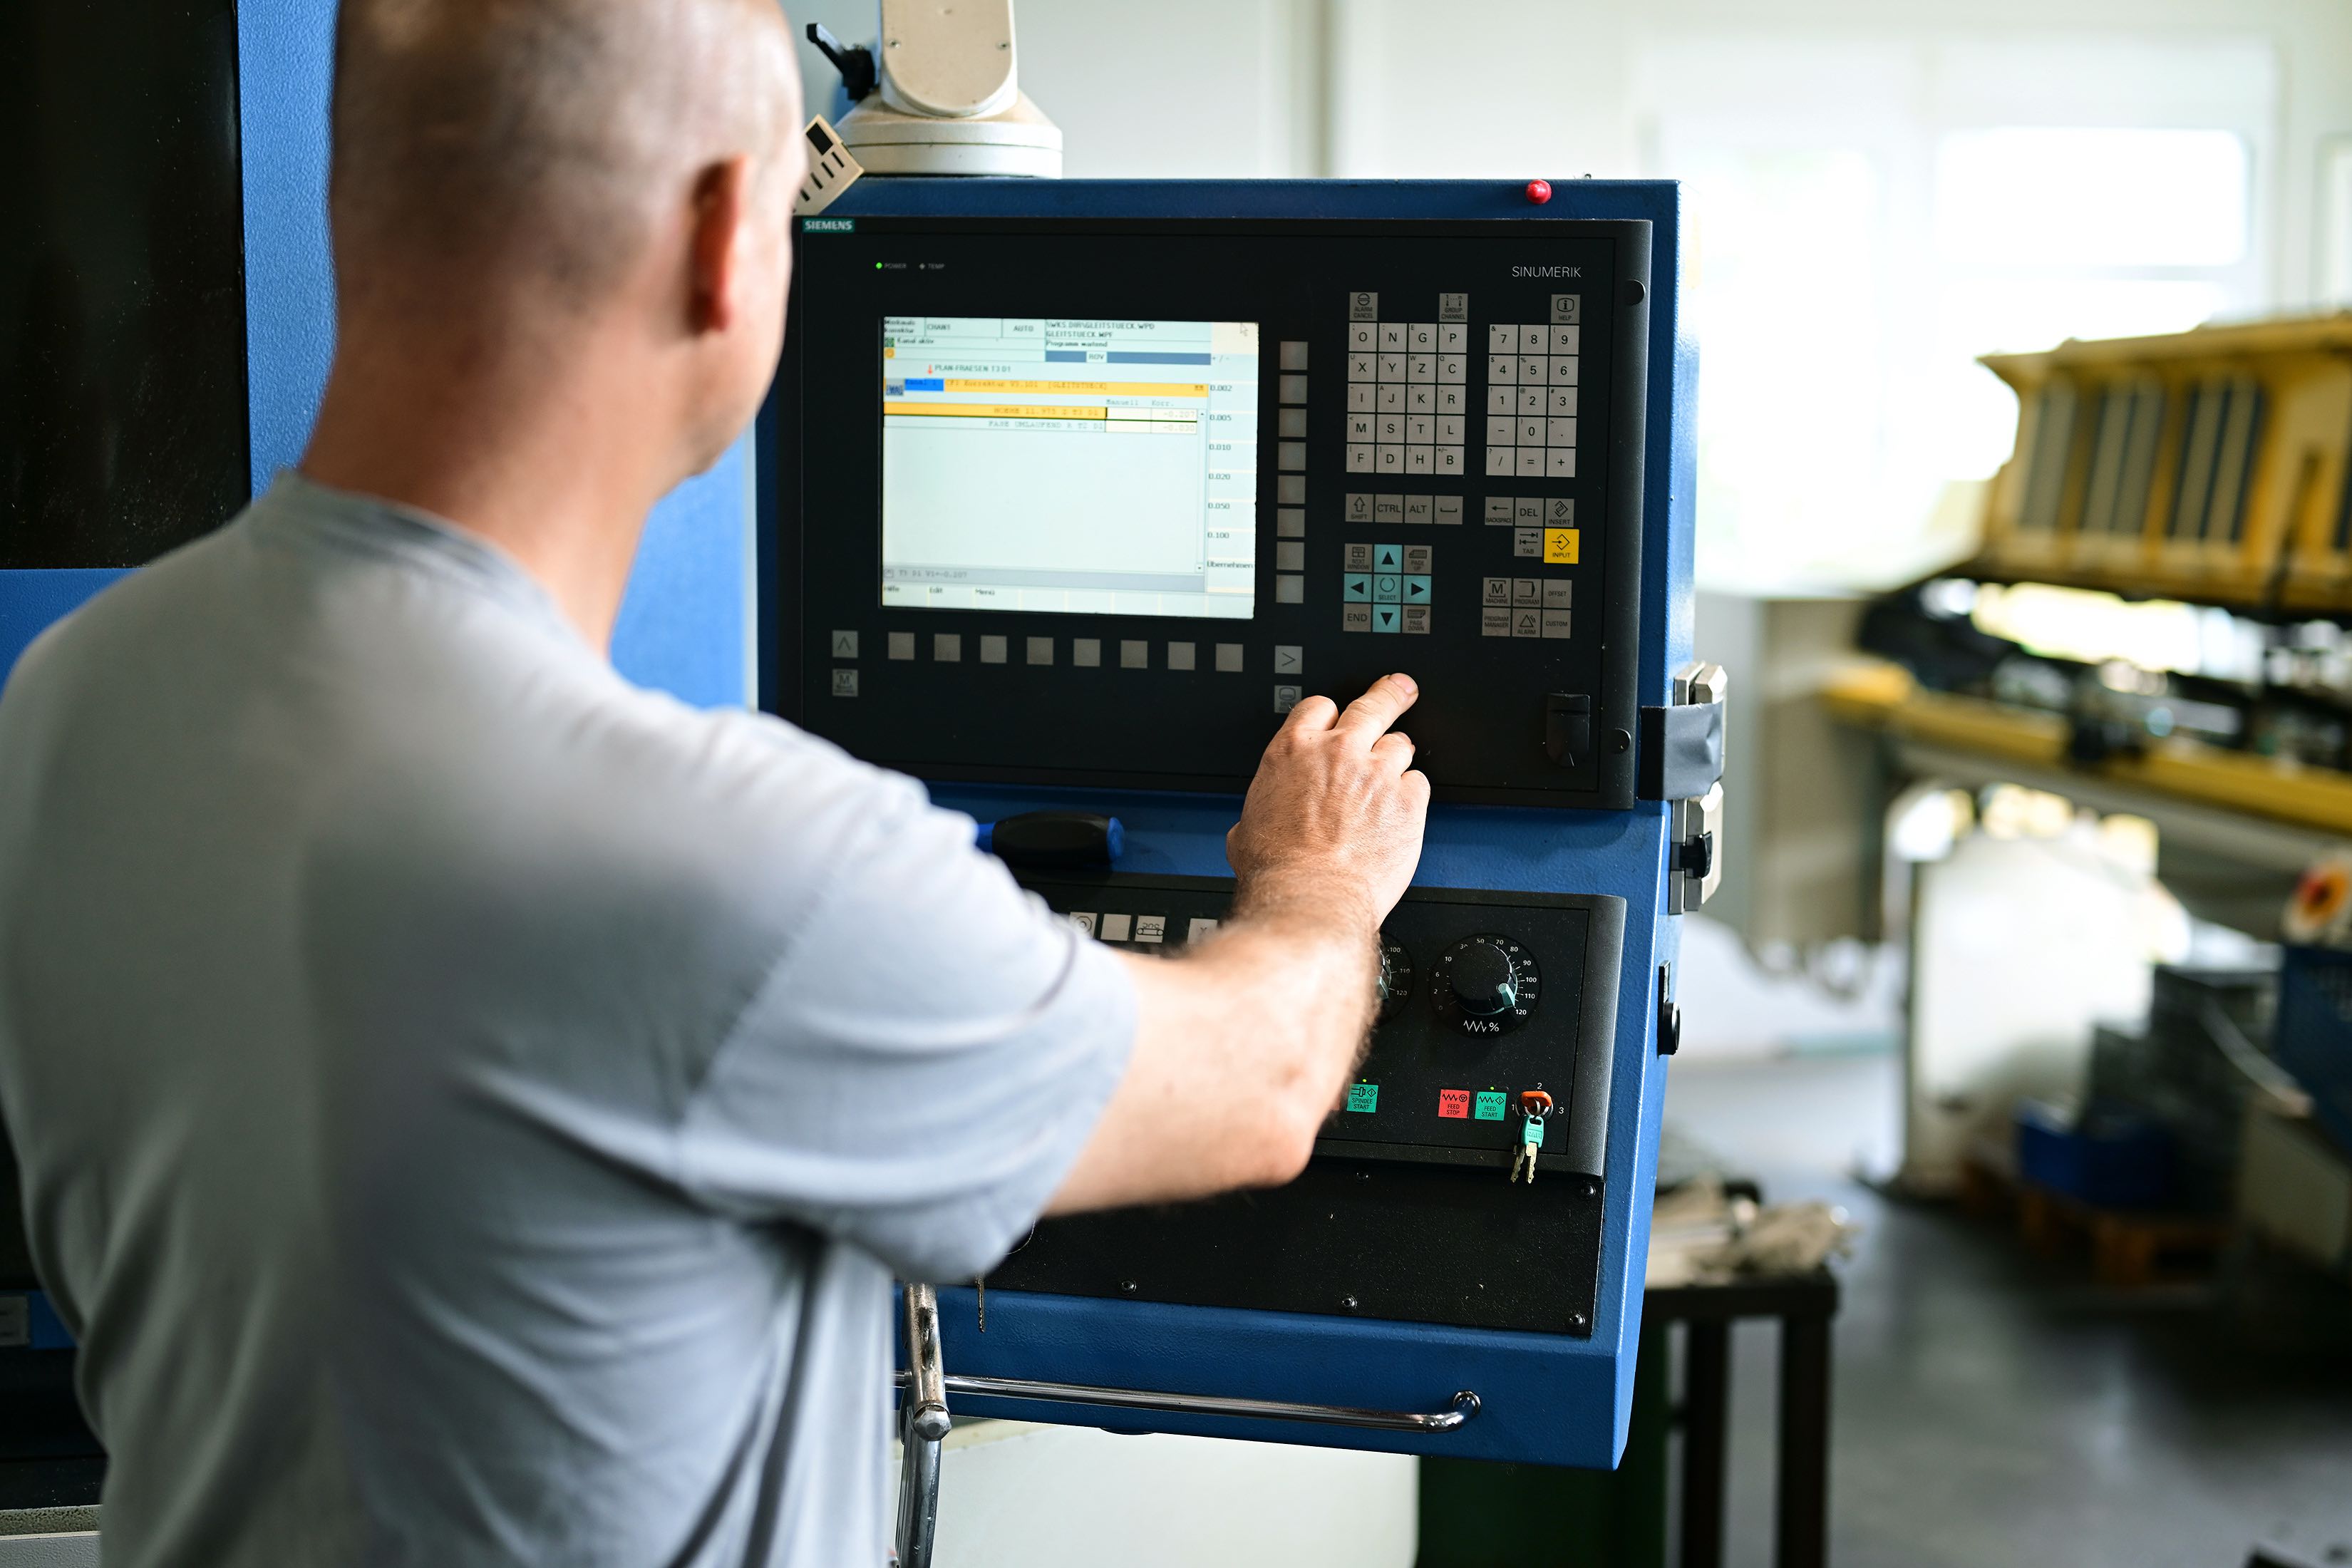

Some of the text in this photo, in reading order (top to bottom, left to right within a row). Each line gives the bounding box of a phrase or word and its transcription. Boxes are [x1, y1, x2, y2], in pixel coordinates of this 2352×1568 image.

[805, 220, 852, 230] SIEMENS
[1512, 266, 1582, 277] SINUMERIK
[1388, 332, 1398, 342] N
[1418, 333, 1427, 343] G
[1449, 333, 1457, 343] P
[1500, 334, 1507, 344] 7
[1530, 334, 1538, 344] 8
[1561, 335, 1568, 344] 9
[1358, 363, 1366, 372] X
[1388, 363, 1397, 373] Y
[1418, 363, 1426, 373] Z
[1448, 363, 1456, 373] C
[1500, 365, 1507, 374] 4
[1530, 366, 1537, 375] 5
[1560, 366, 1567, 376] 6
[1388, 393, 1395, 403] J
[1418, 393, 1425, 403] K
[1448, 394, 1455, 404] R
[1500, 396, 1505, 405] 1
[1529, 396, 1536, 406] 2
[1559, 396, 1567, 406] 3
[1356, 423, 1366, 433] M
[1387, 423, 1395, 433] S
[1417, 424, 1425, 434] T
[1448, 425, 1454, 435] L
[1357, 453, 1364, 463] F
[1386, 454, 1395, 463] D
[1416, 455, 1424, 464] H
[1446, 455, 1454, 465] B
[1377, 504, 1401, 513] CTRL
[1409, 505, 1427, 513] ALT
[1520, 507, 1538, 517] DEL
[1347, 613, 1368, 622] END
